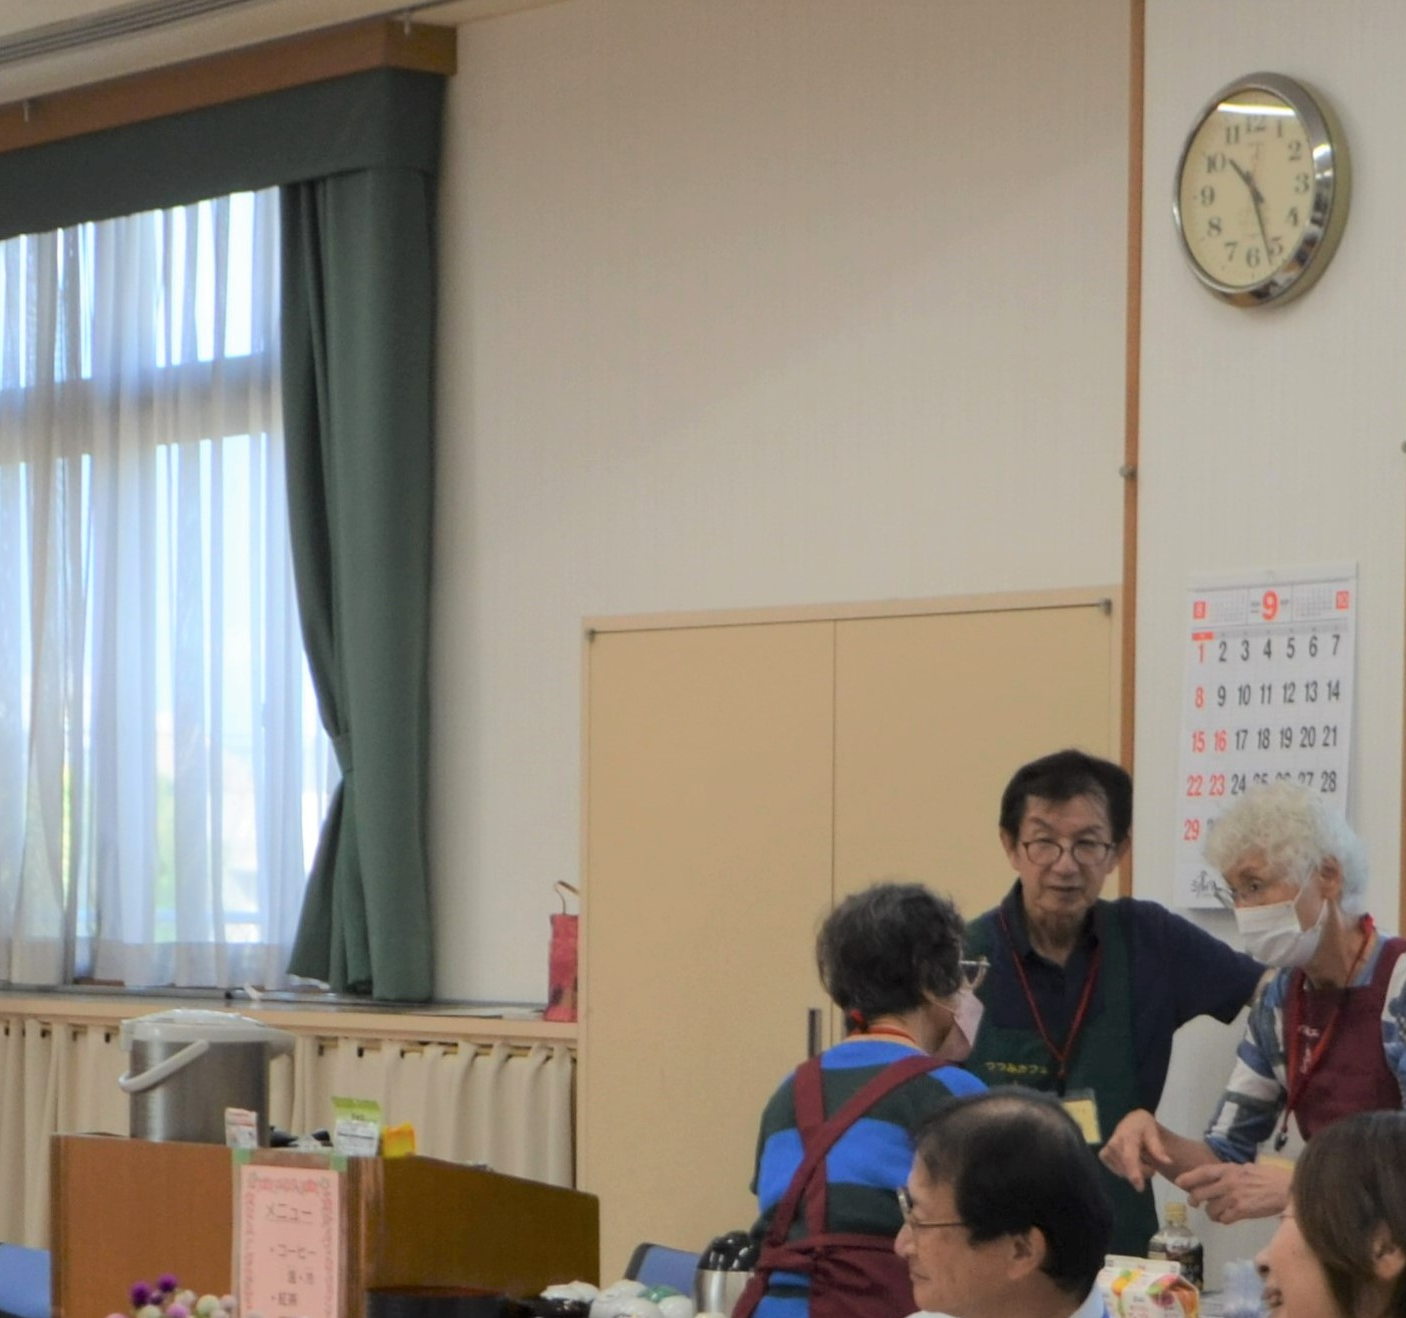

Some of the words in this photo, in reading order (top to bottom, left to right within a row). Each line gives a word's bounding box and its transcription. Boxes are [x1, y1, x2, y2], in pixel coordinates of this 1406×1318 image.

[1246, 115, 1267, 132] 12
[1225, 125, 1240, 145] 11
[1288, 140, 1301, 161] 2
[1205, 153, 1226, 174] 10
[1295, 174, 1310, 194] 3
[1201, 186, 1215, 206] 9
[1207, 217, 1222, 238] 8
[1224, 241, 1238, 262] 7
[1246, 247, 1261, 267] 6
[1270, 236, 1283, 257] 5
[1262, 590, 1279, 620] 9
[1199, 643, 1205, 664] 1
[1219, 641, 1227, 662] 2
[1241, 640, 1250, 661] 3
[1263, 638, 1272, 660] 4
[1286, 637, 1295, 659] 5
[1309, 635, 1318, 657] 6
[1332, 634, 1340, 655] 7
[1195, 687, 1204, 709] 8
[1217, 685, 1226, 707] 9
[1237, 684, 1251, 707] 10
[1260, 683, 1272, 705] 11
[1283, 682, 1295, 704] 12
[1304, 681, 1318, 702] 13
[1327, 680, 1340, 700] 14
[1192, 730, 1205, 752] 15
[1214, 730, 1227, 752] 16
[1235, 729, 1248, 750] 17
[1257, 728, 1270, 750] 18
[1279, 727, 1293, 749] 19
[1299, 725, 1316, 748] 20
[1322, 725, 1337, 747] 21
[1186, 774, 1203, 797] 22
[1208, 774, 1225, 796] 23
[1231, 773, 1246, 795] 24
[1320, 770, 1337, 793] 28
[1183, 818, 1200, 841] 29
[266, 1202, 313, 1220] メニュー
